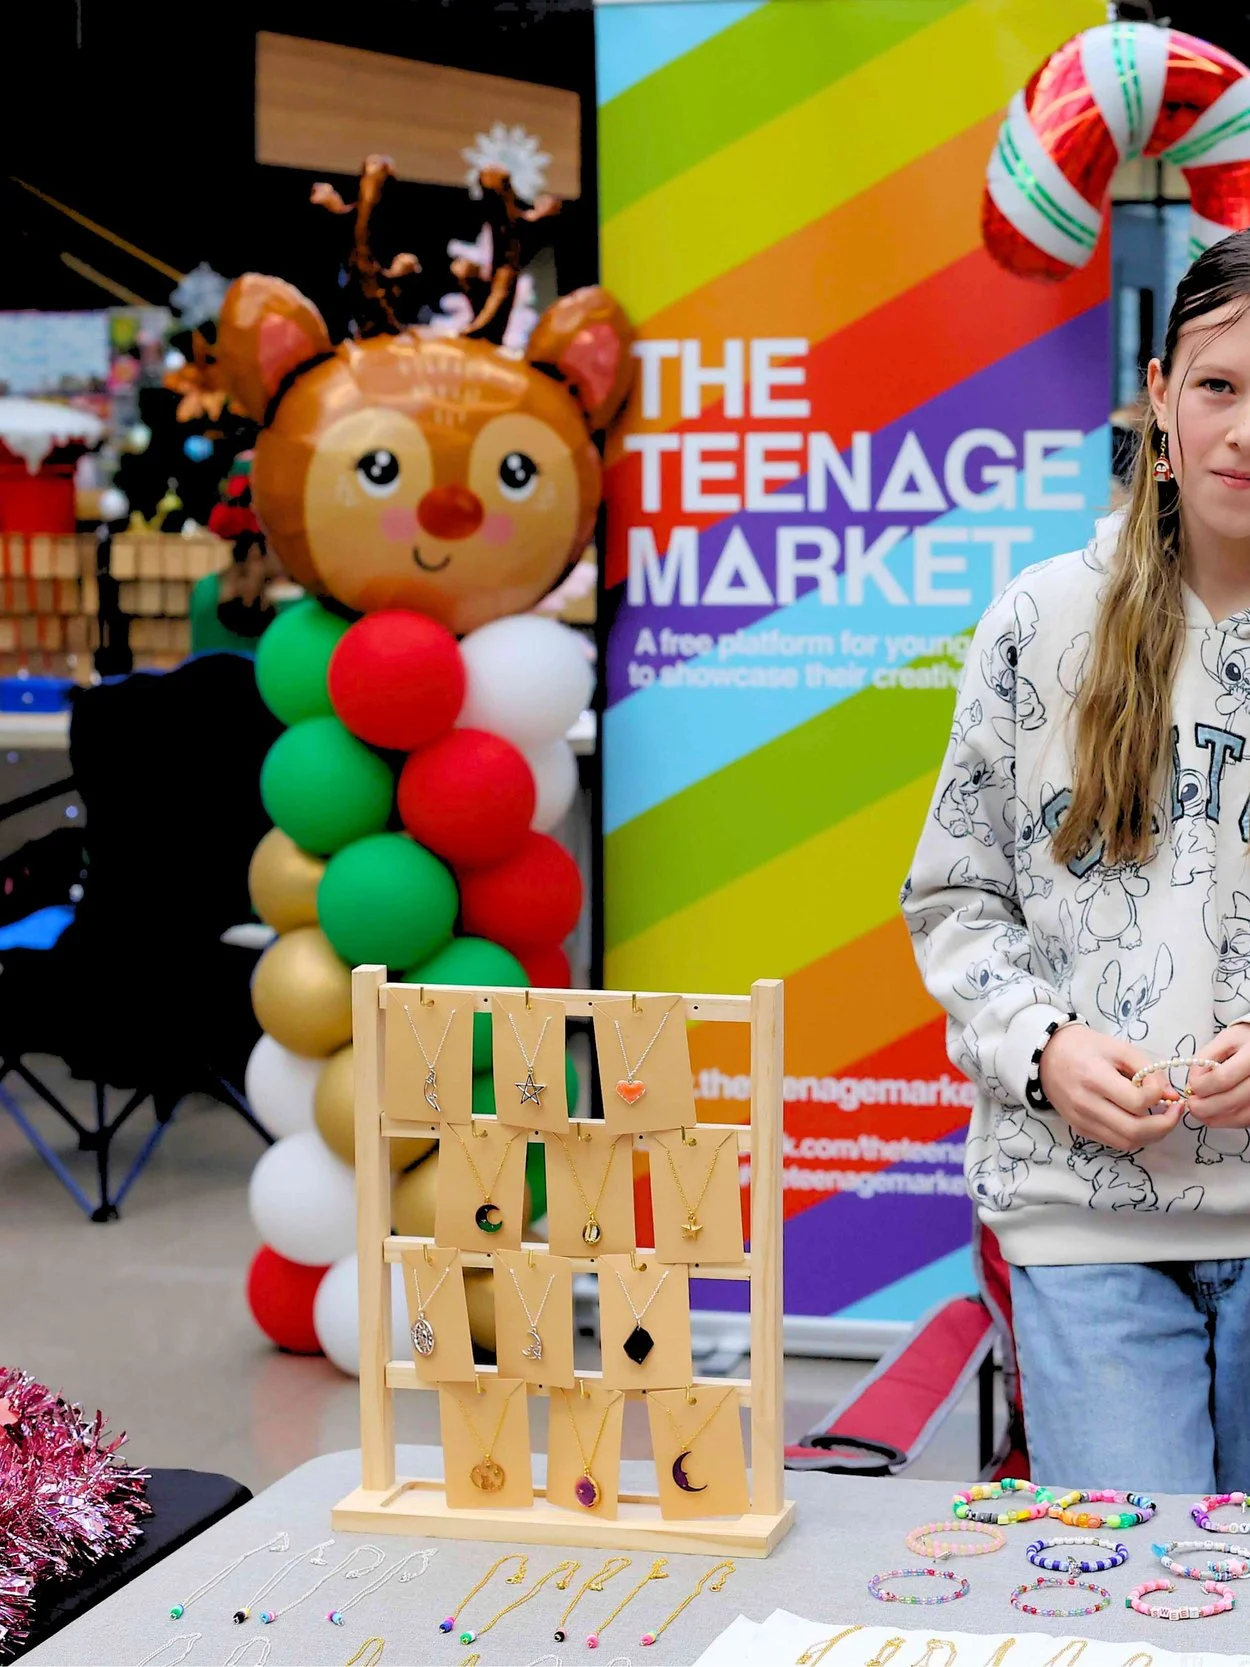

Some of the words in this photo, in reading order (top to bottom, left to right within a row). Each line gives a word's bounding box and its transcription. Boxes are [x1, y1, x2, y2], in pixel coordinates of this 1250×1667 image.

[631, 338, 811, 420] THE
[624, 429, 1085, 514] TEENAGE
[627, 525, 1034, 607] MARKET
[634, 629, 657, 656] A
[660, 627, 714, 657] free
[717, 629, 833, 661] platform
[841, 630, 878, 657] for
[884, 633, 973, 664] young
[628, 663, 652, 688] to
[658, 662, 799, 688] showcase
[806, 663, 868, 689] their
[1152, 1607, 1199, 1621] SWEET
